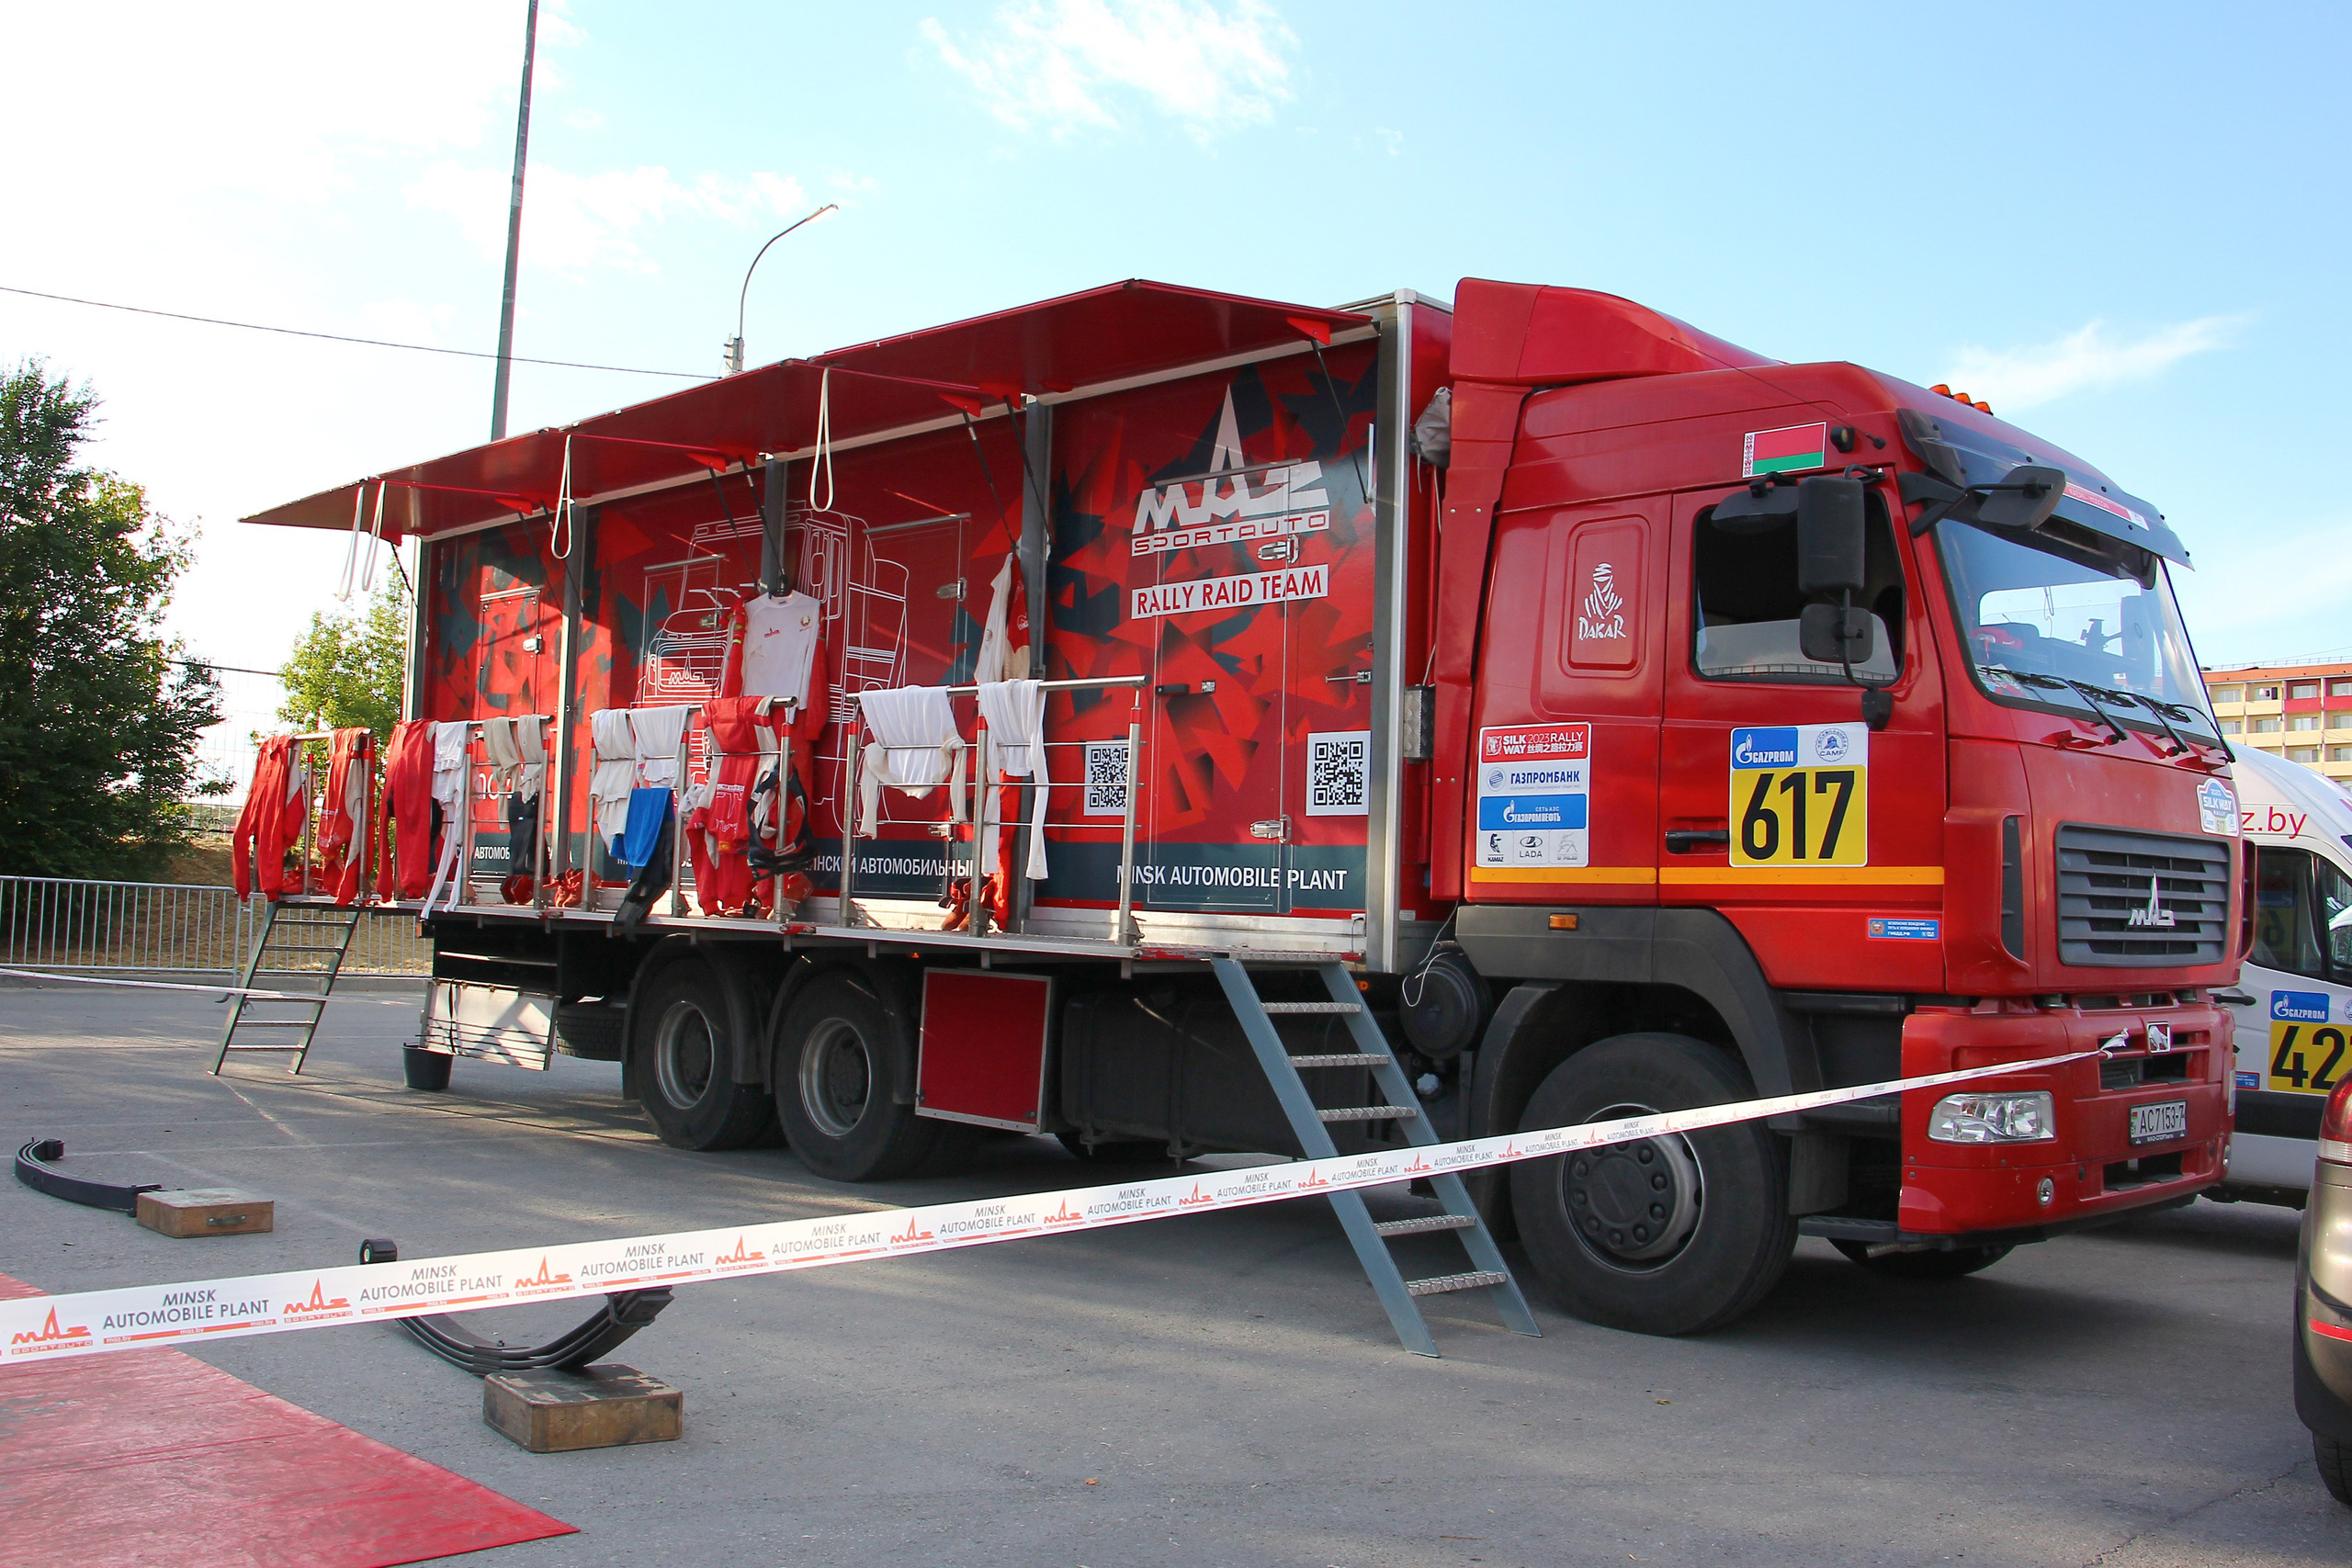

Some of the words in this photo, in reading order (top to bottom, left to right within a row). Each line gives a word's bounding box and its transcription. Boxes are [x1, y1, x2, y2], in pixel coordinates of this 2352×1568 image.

[1135, 513, 1326, 553] SPORTAUTO
[1137, 585, 1193, 614] RALLY
[1203, 579, 1252, 607] RAID
[1261, 570, 1322, 599] TEAM
[1578, 614, 1627, 640] DAKAR
[1503, 735, 1527, 745] SILK
[1528, 733, 1550, 744] 2023
[1550, 731, 1584, 742] RALLY
[1503, 744, 1526, 755] WAY
[1753, 750, 1794, 763] GAZPROM
[1510, 771, 1580, 784] ГАЗПРОМБАНК
[2203, 795, 2219, 809] SILK
[2219, 797, 2233, 811] WAY
[1741, 771, 1855, 860] 617
[1170, 866, 1280, 888] AUTOMOBILE
[1287, 869, 1348, 891] PLANT
[2289, 1009, 2325, 1020] GAZPROM
[1118, 1188, 1147, 1201] MINSK
[975, 1204, 1007, 1218] MINSK
[1087, 1199, 1144, 1215] AUTOMOBILE
[1146, 1195, 1172, 1208] PLANT
[811, 1224, 847, 1237] MINSK
[939, 1216, 1005, 1235] AUTOMOBILE
[1007, 1213, 1036, 1227] PLANT
[625, 1242, 666, 1258] MINSK
[772, 1236, 845, 1255] AUTOMOBILE
[848, 1232, 881, 1247] PLANT
[411, 1265, 458, 1280] MINSK
[580, 1256, 663, 1278] AUTOMOBILE
[667, 1252, 705, 1269] PLANT
[360, 1280, 454, 1302] AUTOMOBILE
[460, 1275, 503, 1291] PLANT
[515, 1285, 575, 1296] SPORTAUTO
[163, 1289, 217, 1306] MINSK
[102, 1305, 213, 1329] AUTOMOBILE
[220, 1300, 269, 1318] PLANT
[284, 1311, 353, 1323] SPORTAUTO
[107, 1335, 131, 1344] maz.by
[180, 1327, 204, 1336] maz.by
[250, 1319, 274, 1327] maz.by
[11, 1340, 93, 1355] SPORTAUTO
